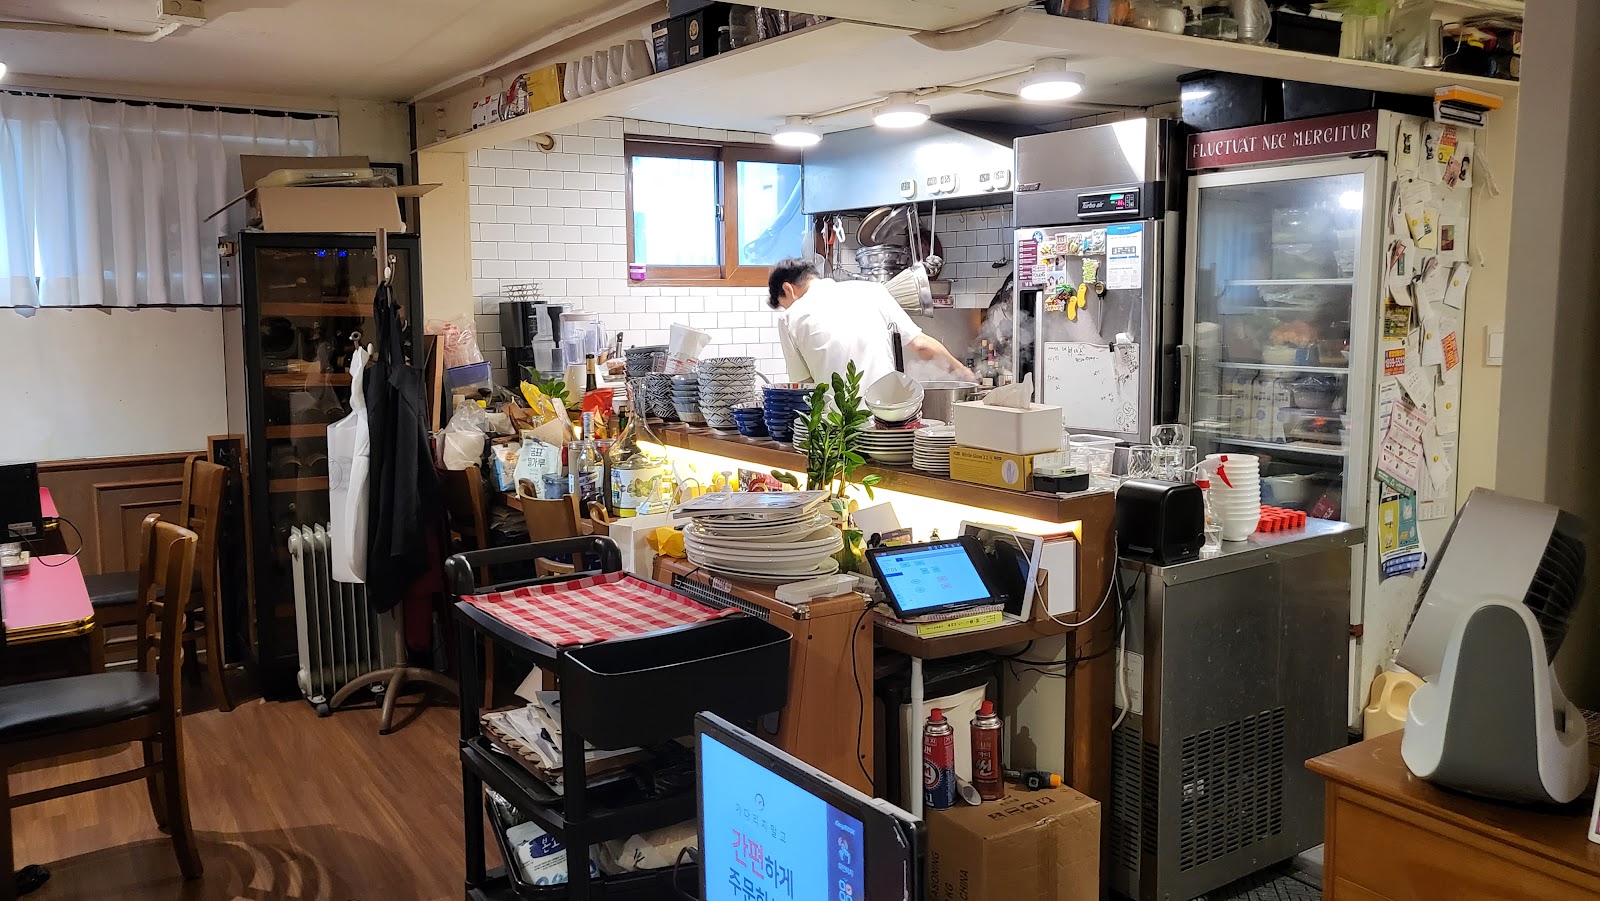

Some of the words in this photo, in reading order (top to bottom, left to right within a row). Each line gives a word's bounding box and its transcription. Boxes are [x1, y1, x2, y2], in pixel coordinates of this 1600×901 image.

[1192, 136, 1258, 159] FLUCTUAT
[1262, 132, 1287, 151] NEC
[527, 457, 546, 468] 밀가루
[732, 828, 794, 900] 간편하게
[929, 851, 940, 901] ASONING
[959, 869, 969, 901] CHINA
